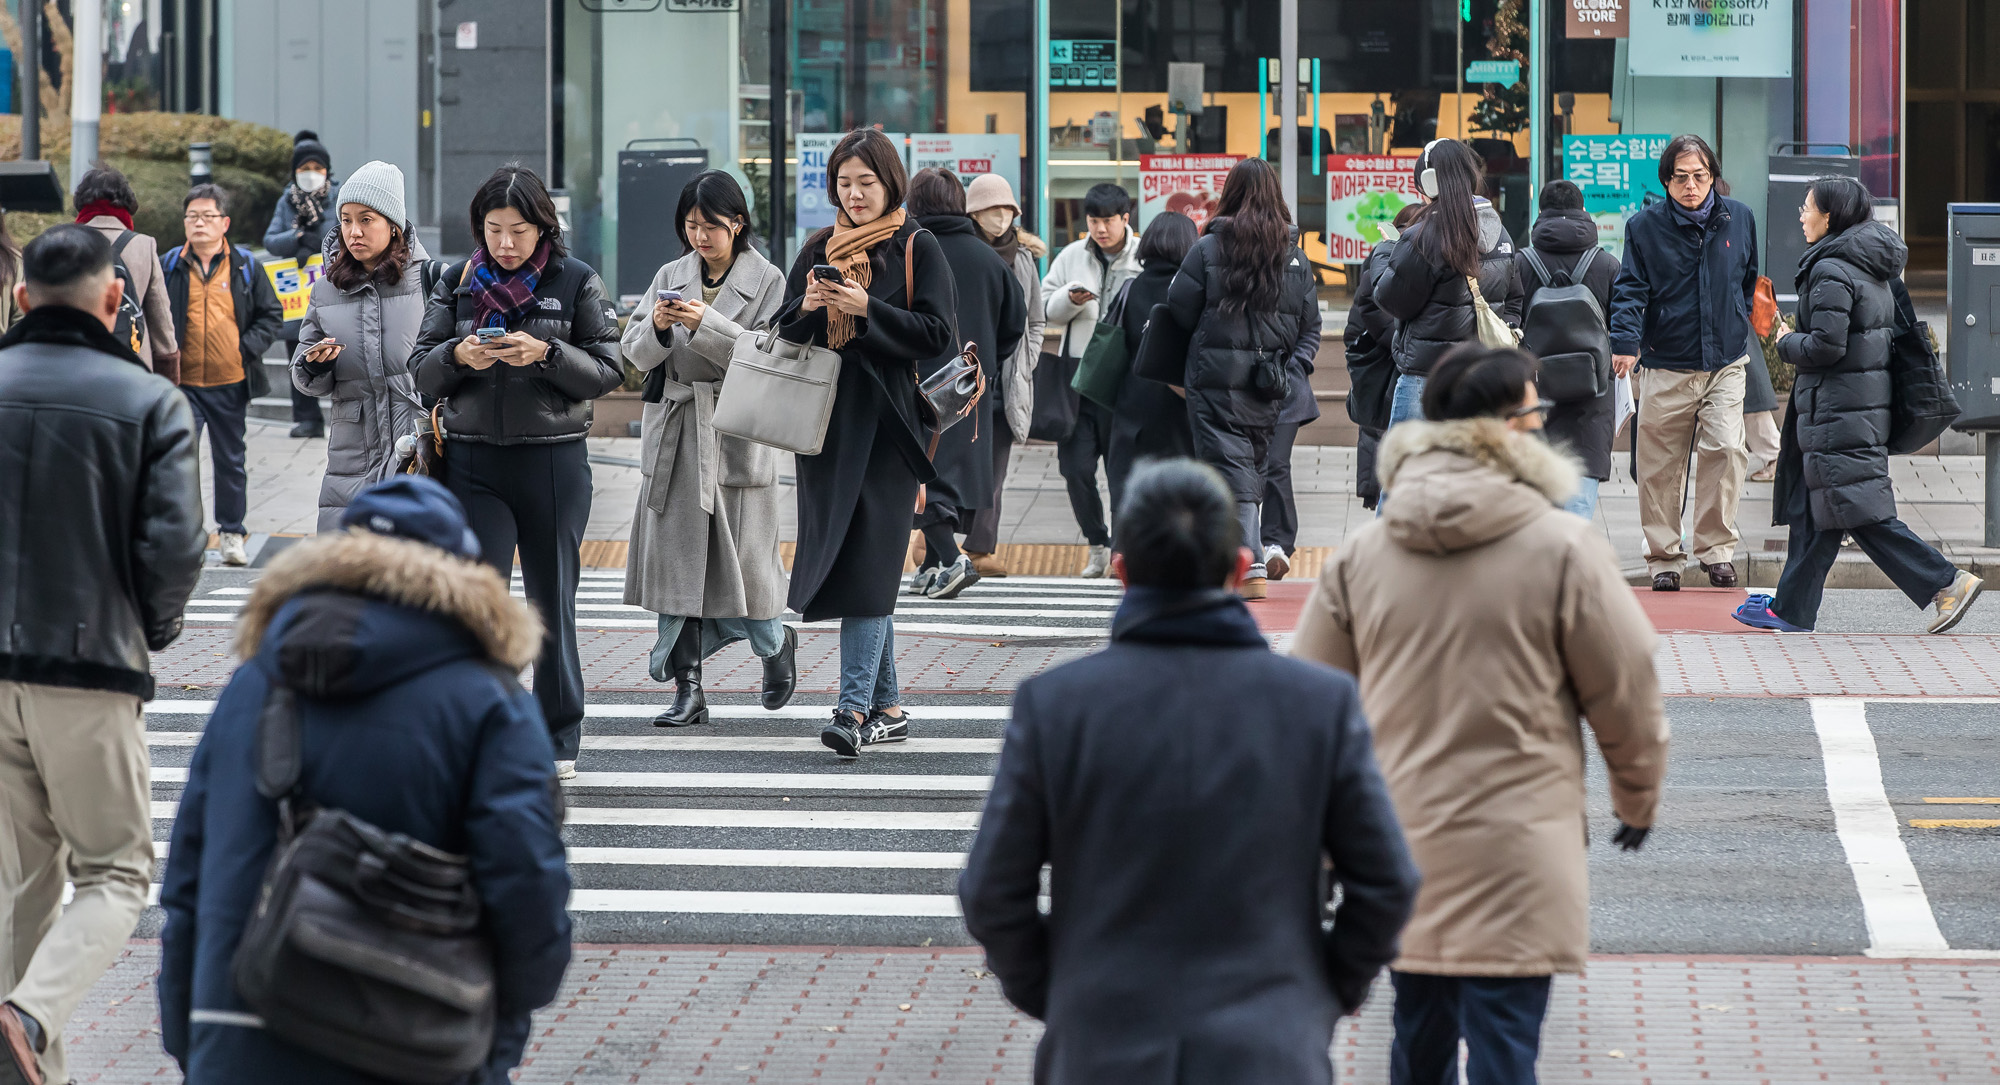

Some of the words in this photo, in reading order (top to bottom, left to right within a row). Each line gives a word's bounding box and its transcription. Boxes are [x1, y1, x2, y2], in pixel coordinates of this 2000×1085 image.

[1573, 0, 1622, 9] GLOBAL
[1653, 0, 1684, 9] KT와
[1687, 0, 1769, 10] Microsoft가
[1578, 10, 1617, 22] STORE
[1667, 12, 1690, 27] 함께
[1694, 12, 1755, 27] 열어갑니다
[1053, 46, 1067, 58] kt
[1568, 138, 1667, 160] 수능수험생
[961, 162, 989, 172] K-AI
[1345, 158, 1395, 170] 수능수험생
[1569, 162, 1630, 190] 주목!
[1331, 175, 1370, 201] 에어팟
